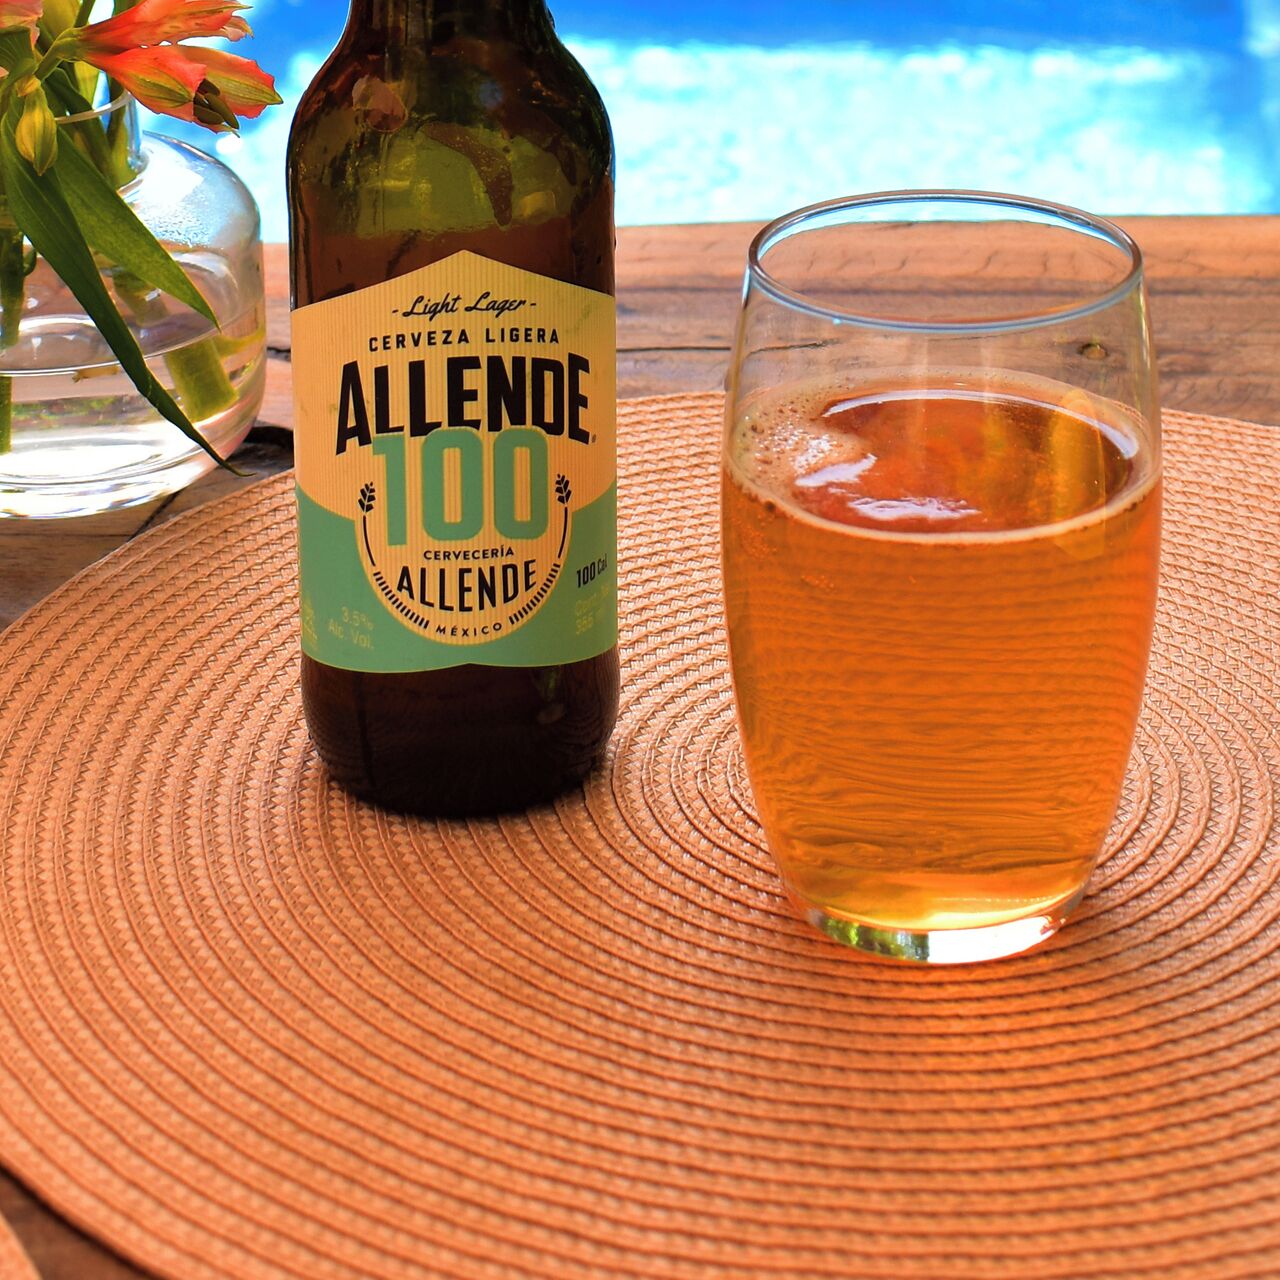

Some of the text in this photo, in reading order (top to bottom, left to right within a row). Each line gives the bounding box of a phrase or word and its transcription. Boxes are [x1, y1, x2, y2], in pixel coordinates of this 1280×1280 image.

[402, 291, 526, 321] Light Lager
[369, 328, 559, 352] CERVEZA LIGERA
[335, 352, 591, 456] ALLENDE
[372, 426, 549, 546] 100
[423, 545, 514, 561] CERVECERÍA
[397, 559, 537, 612] ALLENDE
[576, 561, 596, 588] 100
[436, 622, 502, 637] MÉXICO
